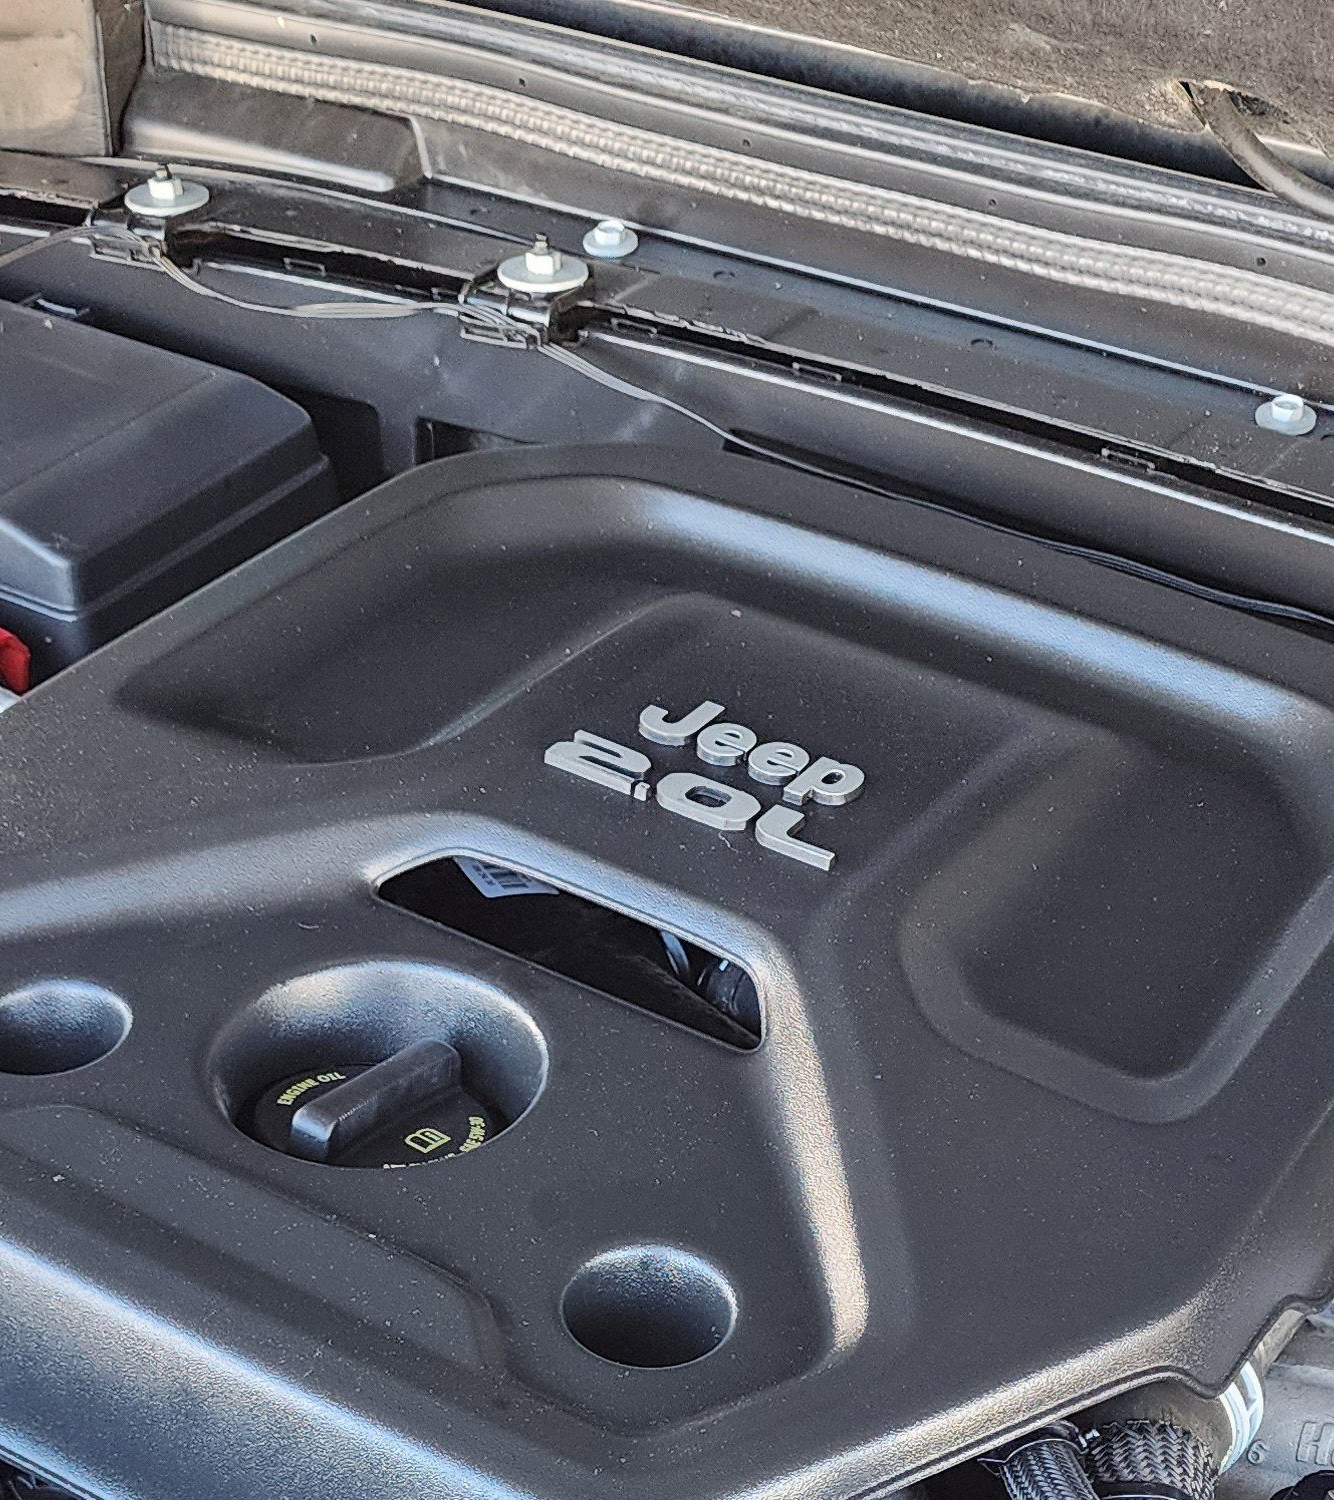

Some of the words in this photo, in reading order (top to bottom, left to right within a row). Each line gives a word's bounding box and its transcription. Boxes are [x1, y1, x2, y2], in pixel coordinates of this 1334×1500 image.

[544, 729, 836, 872] 2.0L
[638, 700, 865, 806] Jeep
[276, 1077, 319, 1106] ENGINE
[317, 1071, 347, 1083] OIL
